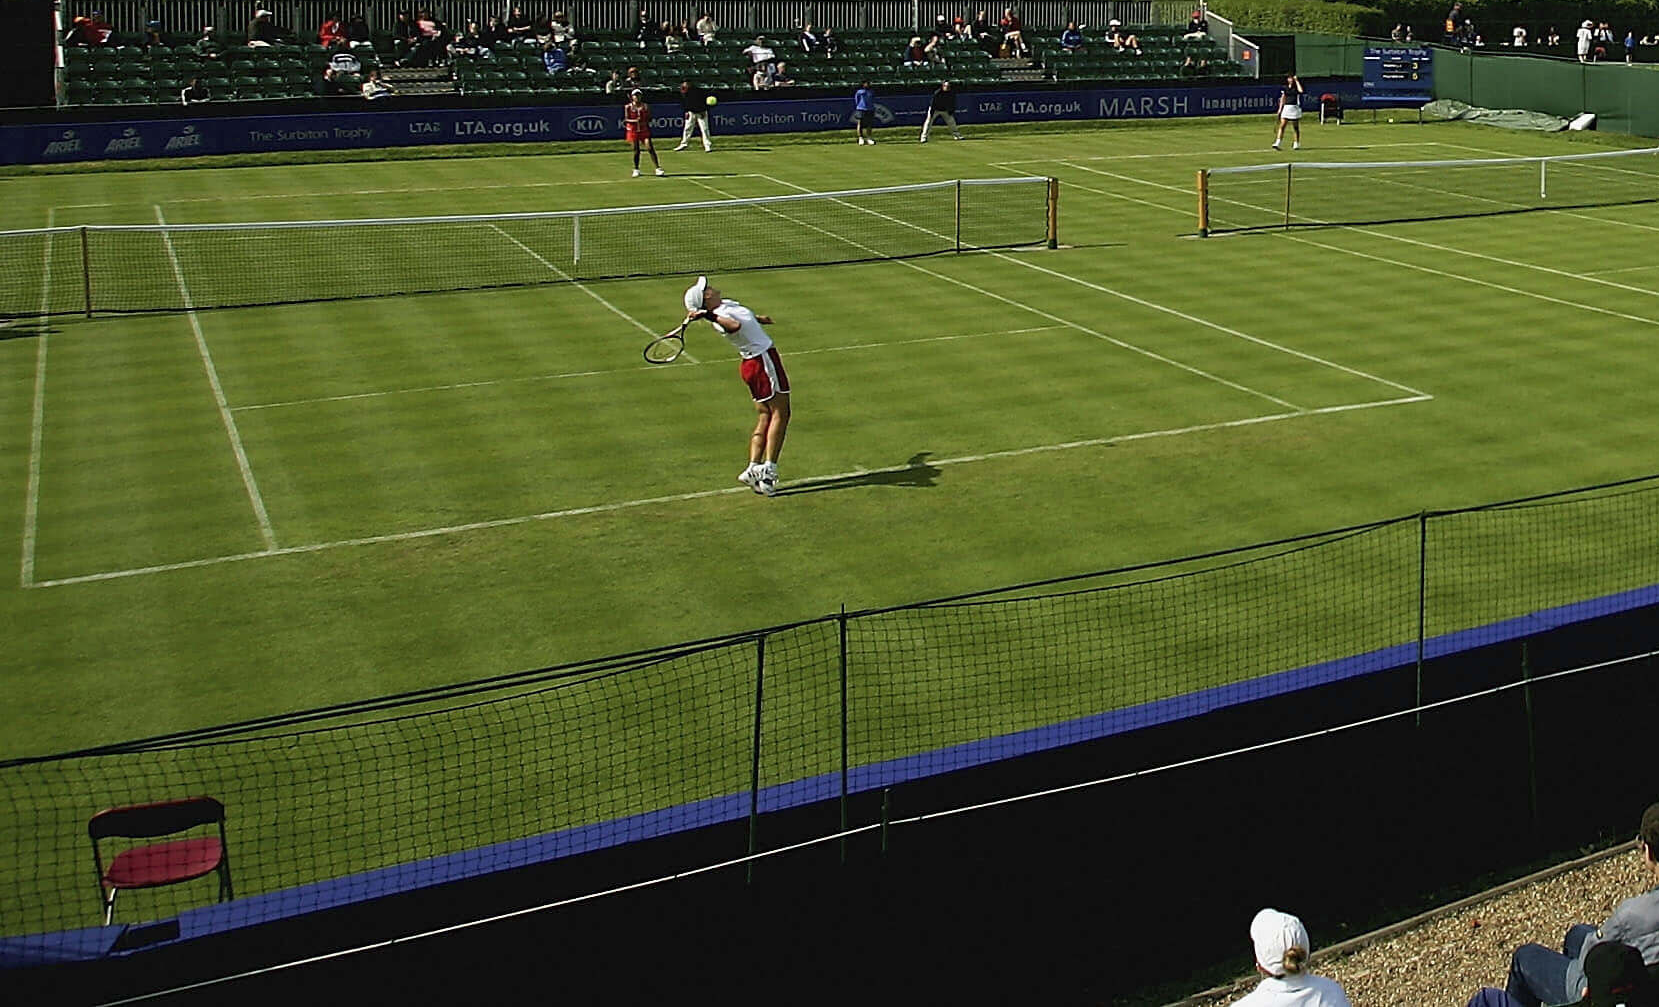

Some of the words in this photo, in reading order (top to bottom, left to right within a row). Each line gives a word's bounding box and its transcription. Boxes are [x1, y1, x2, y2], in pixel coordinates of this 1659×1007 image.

[1012, 101, 1081, 115] LTA.org.uk
[1099, 96, 1188, 116] MARSH
[576, 119, 604, 131] KIA
[712, 115, 736, 126] The
[742, 113, 795, 125] Surbiton
[800, 111, 842, 124] Trophy
[248, 130, 273, 142] The
[277, 129, 329, 142] Surbiton
[333, 127, 373, 139] Trophy
[455, 119, 550, 136] LTA.org.uk
[104, 135, 143, 153] ARIEL
[165, 134, 202, 151] ARIEL
